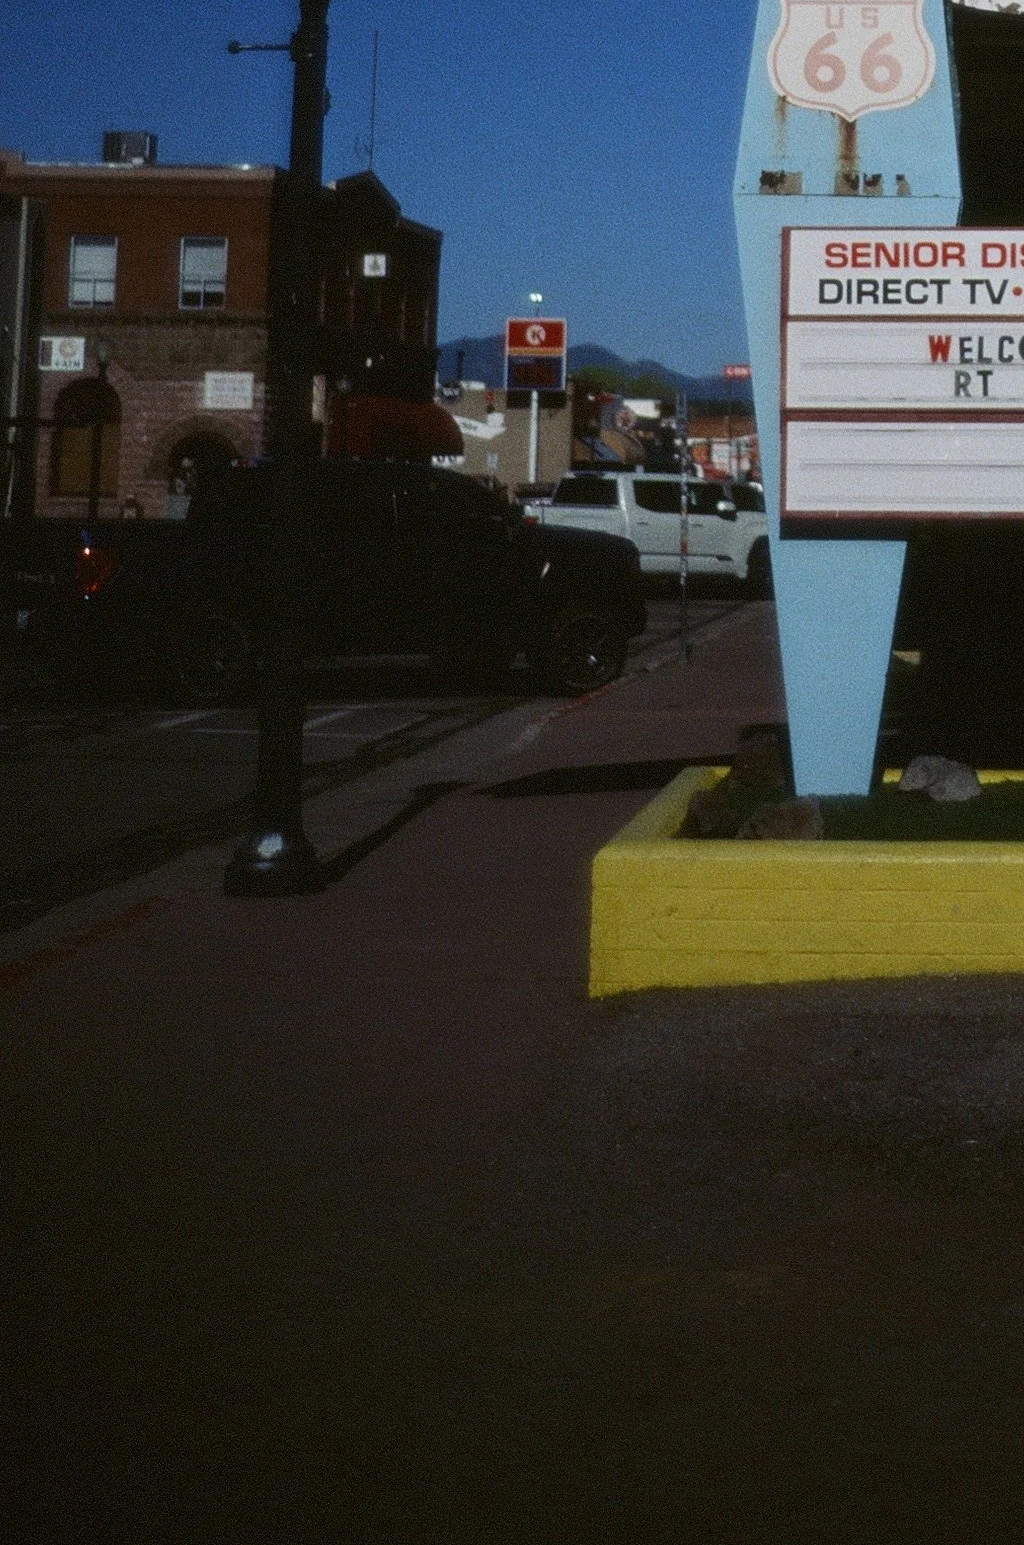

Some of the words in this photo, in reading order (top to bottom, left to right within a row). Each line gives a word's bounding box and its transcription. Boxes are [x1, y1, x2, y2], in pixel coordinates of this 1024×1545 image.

[804, 31, 903, 93] 66
[824, 241, 967, 269] SENIOR
[818, 278, 951, 305] DIRECT
[962, 278, 1009, 305] TV
[953, 368, 994, 398] RT
